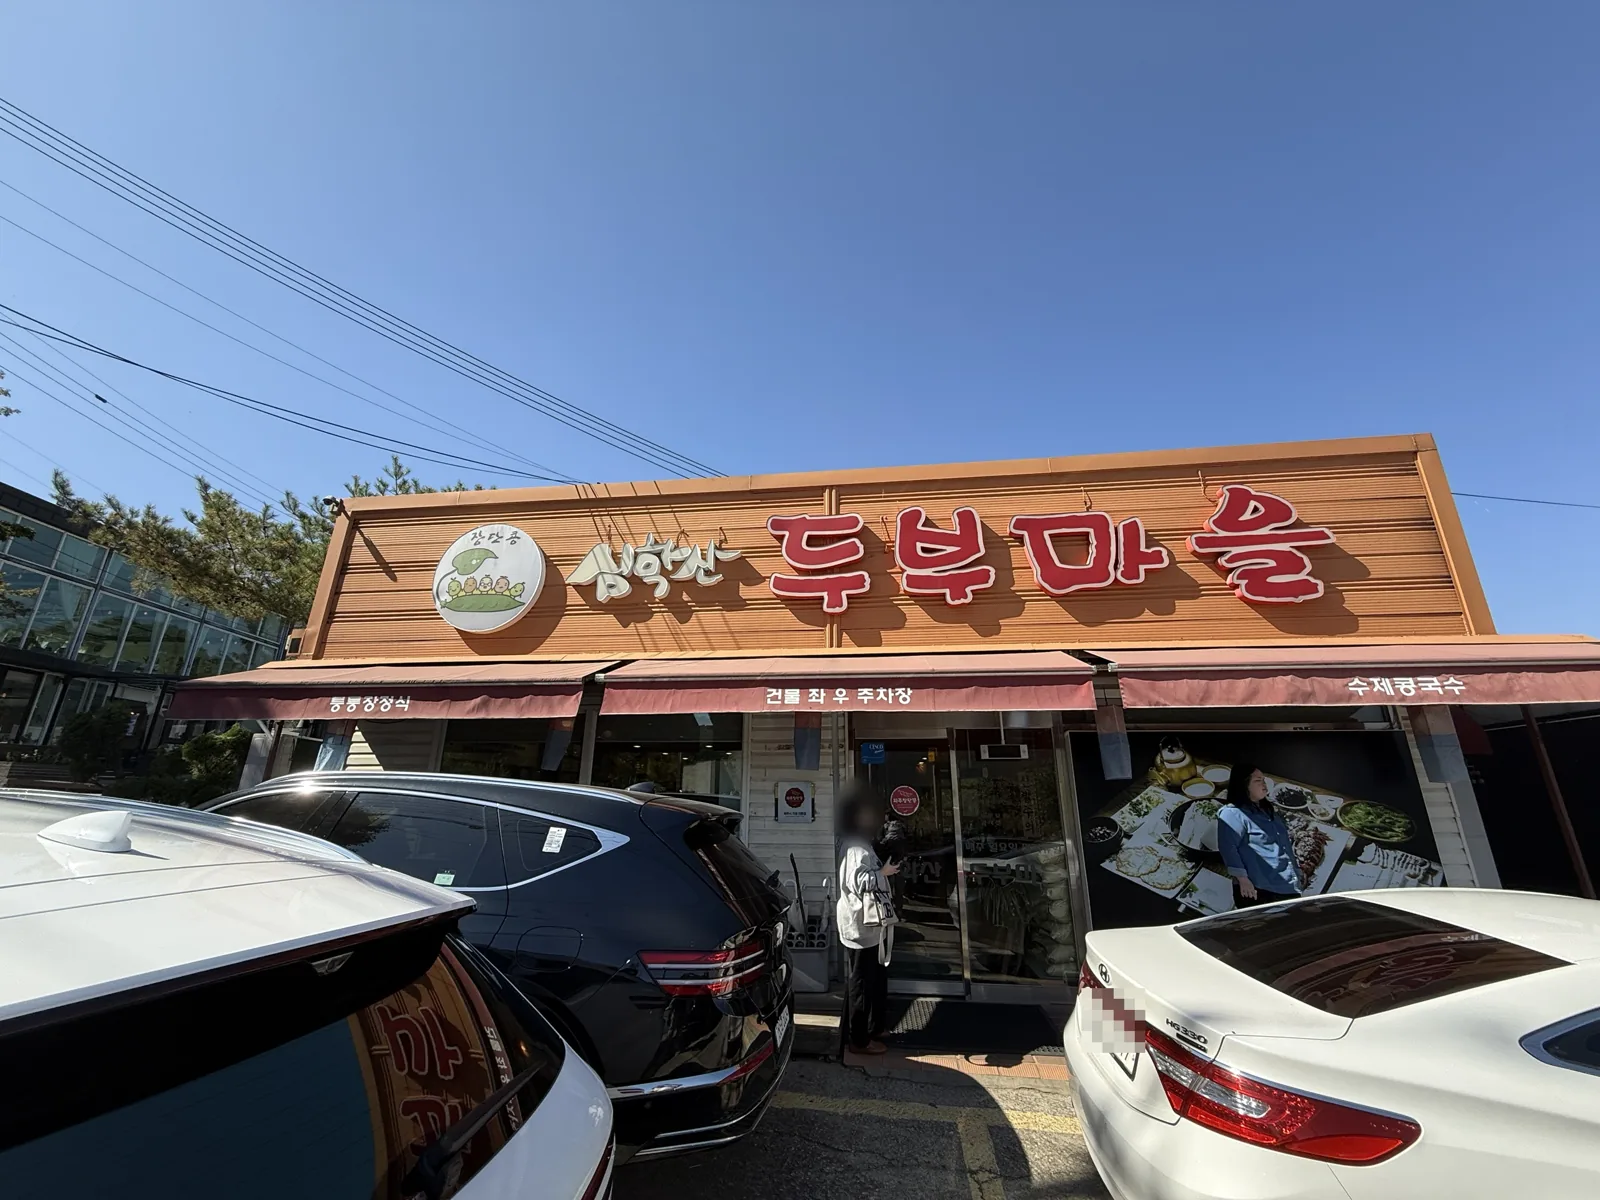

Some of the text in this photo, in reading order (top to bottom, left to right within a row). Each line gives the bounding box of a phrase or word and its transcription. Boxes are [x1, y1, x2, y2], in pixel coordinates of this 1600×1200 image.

[470, 530, 521, 546] 장단콩
[766, 483, 1338, 614] 두부마을
[565, 532, 742, 603] 심학산
[766, 687, 913, 705] 건물 좌 우 주차장
[1348, 676, 1466, 697] 수제콩국수
[1165, 1017, 1208, 1044] HG330
